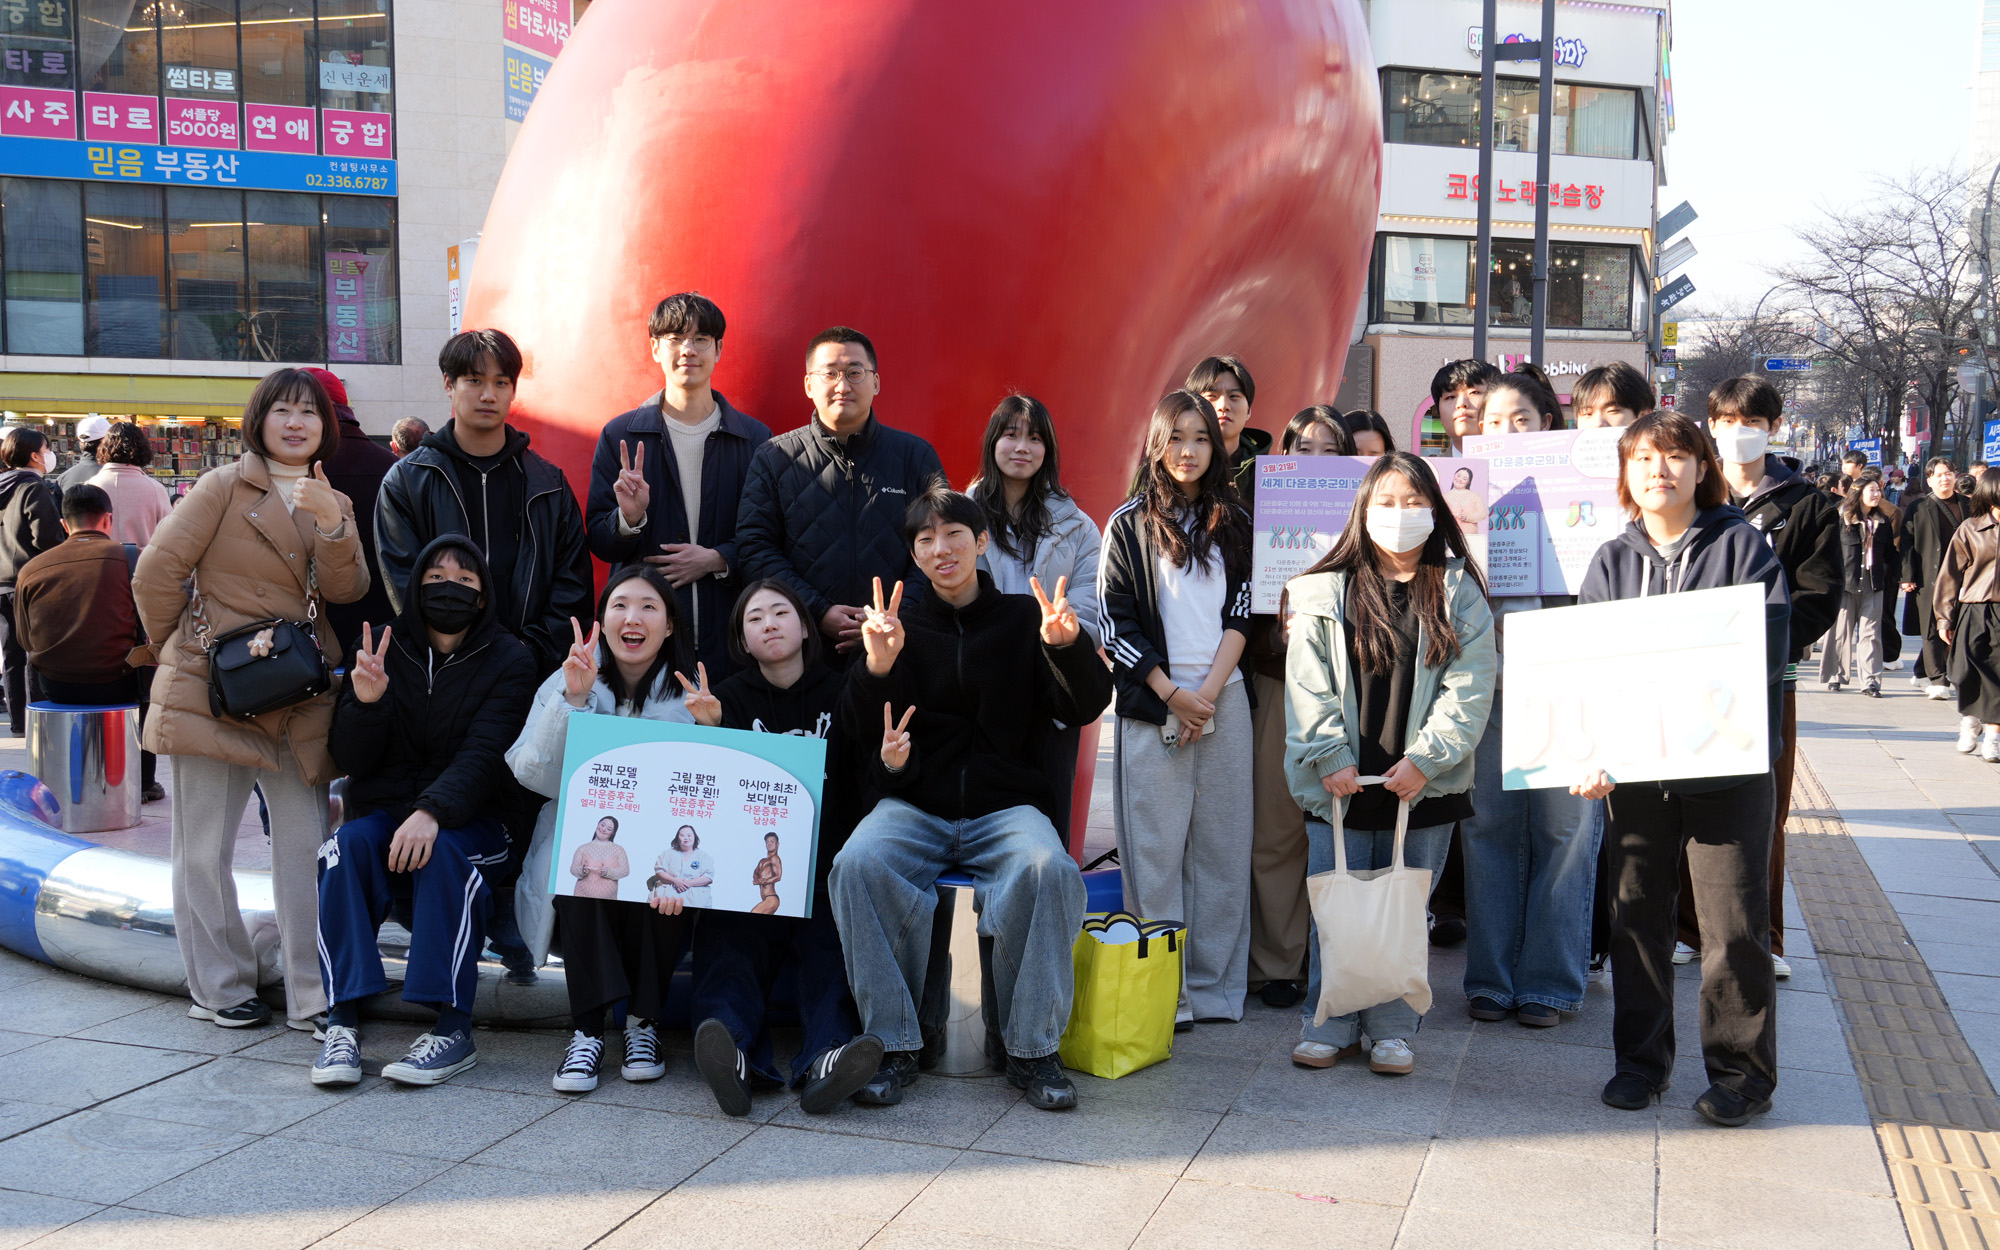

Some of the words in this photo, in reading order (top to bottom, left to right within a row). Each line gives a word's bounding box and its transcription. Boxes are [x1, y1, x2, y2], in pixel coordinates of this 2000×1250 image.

[5, 50, 68, 74] 타로
[167, 68, 235, 90] 썸타로
[323, 67, 389, 89] 신년운세
[508, 57, 533, 94] 믿음
[6, 100, 69, 125] 사주
[92, 106, 153, 130] 타로
[181, 108, 221, 121] 셔플당
[170, 120, 236, 140] 5000원
[252, 115, 309, 141] 연애
[330, 120, 386, 146] 궁합
[88, 146, 144, 177] 믿음
[154, 151, 240, 182] 부동산
[330, 161, 388, 173] 컨설팅사무소
[306, 174, 388, 190] 02.336.6787
[335, 278, 360, 354] 부동산
[1263, 464, 1276, 473] 3월
[1278, 462, 1297, 472] 21일!
[1493, 455, 1555, 467] 다운증후군의
[1559, 454, 1569, 464] 날
[1261, 478, 1283, 489] 세계
[1286, 478, 1349, 490] 다운증후군의
[592, 763, 613, 775] 구찌
[616, 766, 637, 778] 모델
[589, 776, 638, 790] 해봤나요?
[671, 771, 692, 783] 그림
[695, 774, 716, 786] 팔면
[668, 784, 699, 797] 수백만
[702, 787, 720, 798] 원!!
[739, 779, 770, 791] 아시아
[773, 782, 797, 794] 최초!
[588, 789, 635, 802] 다운증후군
[746, 793, 788, 806] 보디빌더
[599, 800, 614, 809] 골드
[616, 803, 640, 812] 스테인
[669, 797, 715, 810] 다운증후군
[671, 808, 695, 817] 정은혜
[696, 810, 712, 819] 작가
[743, 805, 789, 818] 다운증후군
